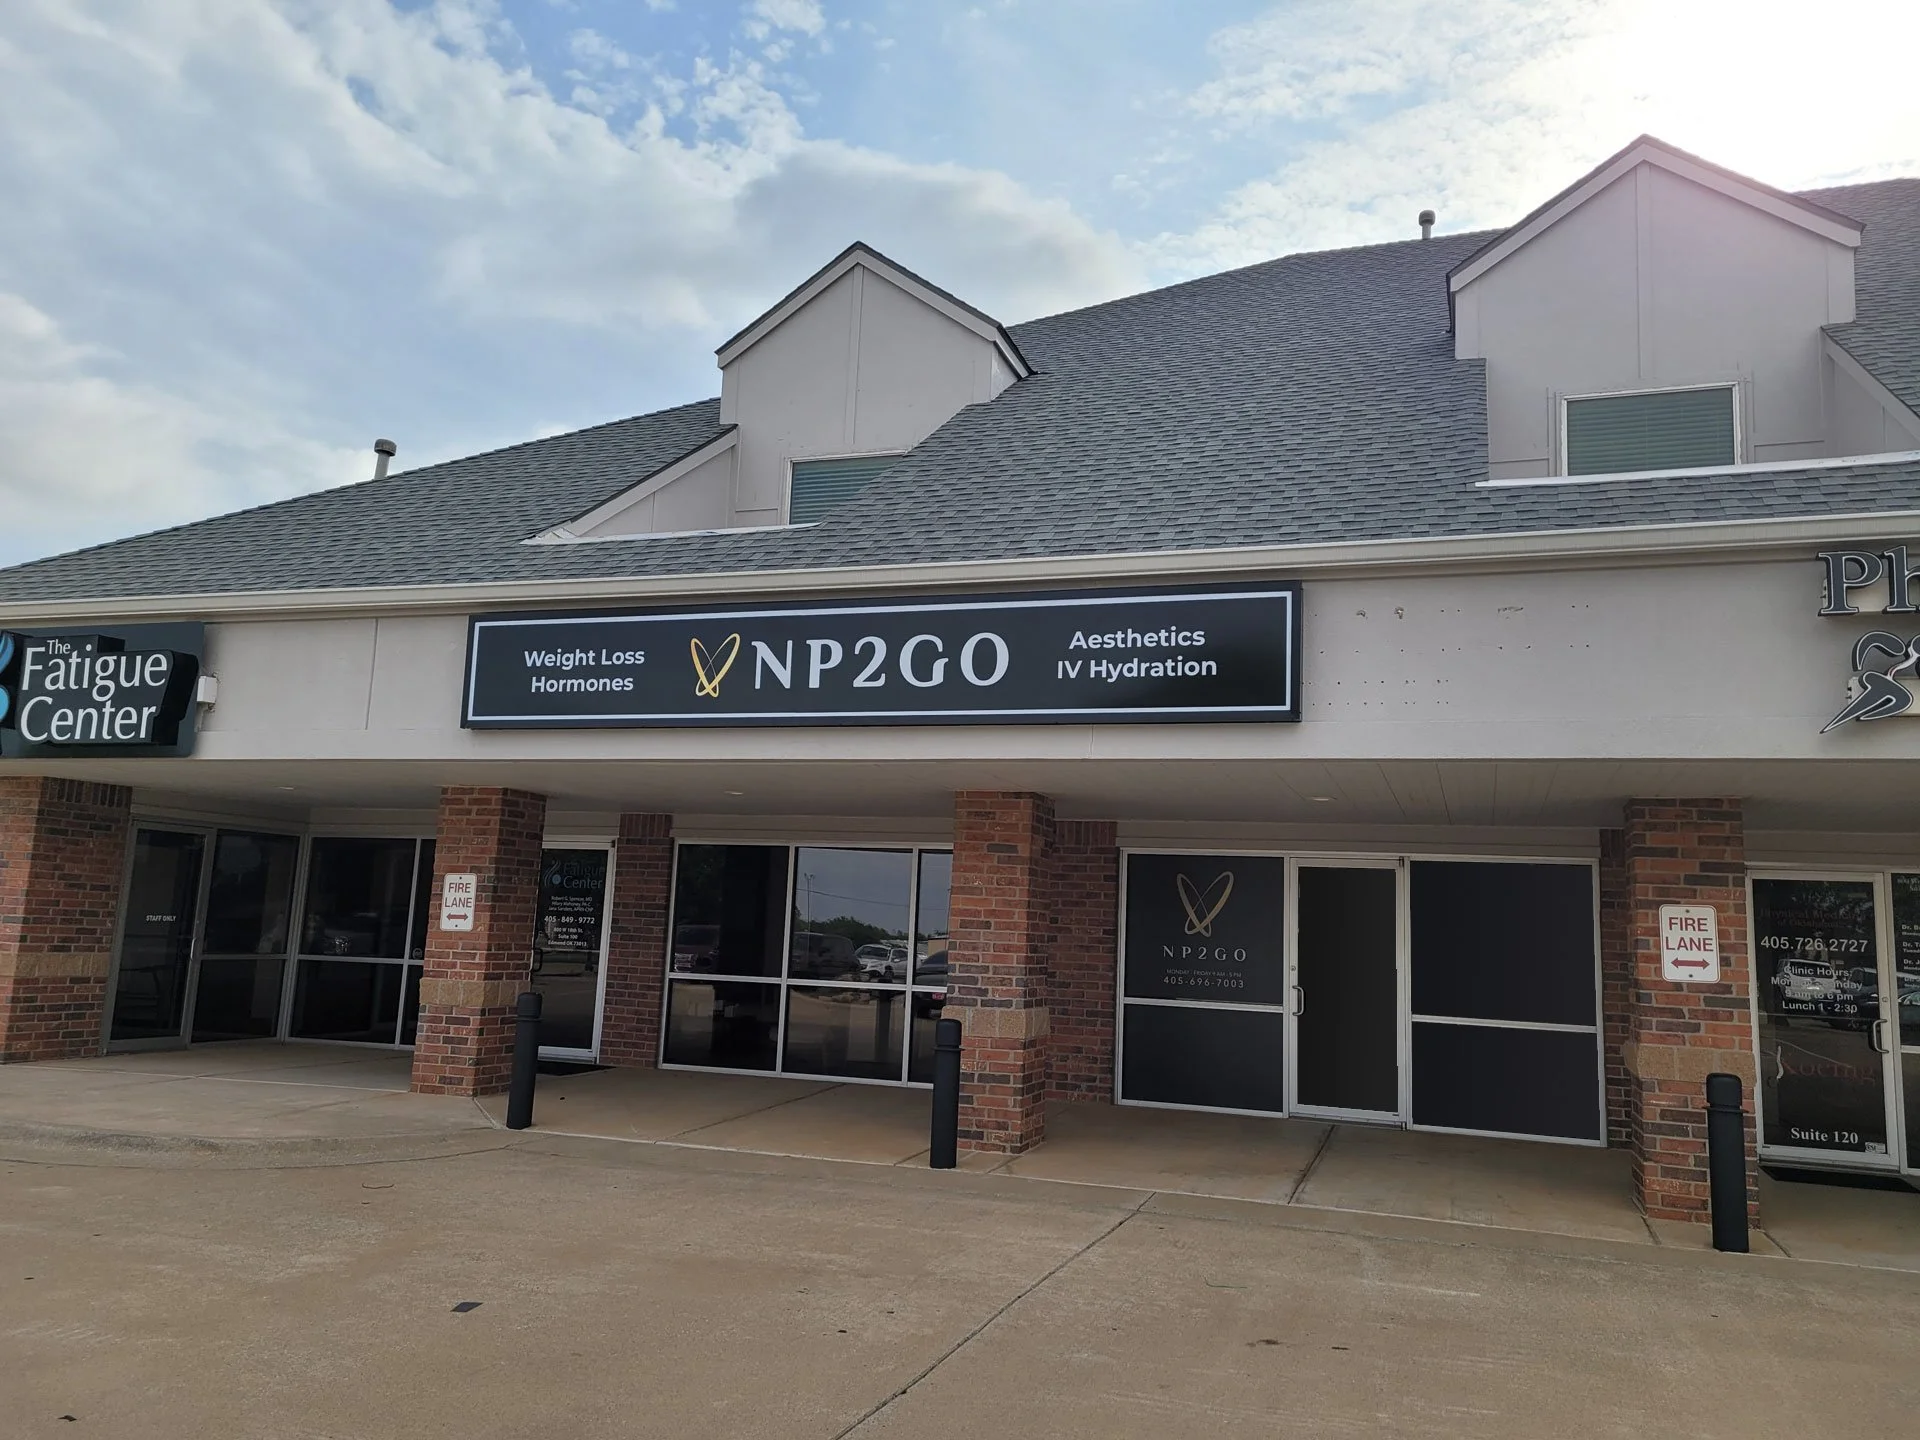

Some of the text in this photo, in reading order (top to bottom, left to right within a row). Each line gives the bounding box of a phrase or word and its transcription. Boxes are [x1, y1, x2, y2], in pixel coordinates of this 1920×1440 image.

[1069, 626, 1206, 649] Aesthetics
[47, 639, 71, 655] The
[525, 649, 645, 670] Weight Loss
[752, 632, 1011, 690] NP2GO
[22, 644, 167, 701] Fatigue
[1057, 656, 1217, 682] IV Hydration
[531, 677, 633, 692] Hormones
[20, 696, 157, 741] Center
[448, 882, 472, 893] FIRE
[563, 875, 603, 889] Center
[444, 897, 472, 908] LANE
[145, 914, 177, 922] STAFF ONLY
[578, 916, 595, 924] 9772
[1668, 916, 1709, 932] FIRE
[1665, 936, 1714, 952] LANE
[1760, 935, 1868, 953] 405.726.2727
[1162, 945, 1247, 962] NP2GO
[1783, 965, 1852, 978] Clinic Hours:
[1163, 976, 1245, 989] 405-696-7003
[1771, 976, 1813, 989] Monay
[1836, 993, 1854, 1002] pm
[1782, 1001, 1815, 1011] Lunch
[1818, 1003, 1824, 1011] 1
[1834, 1003, 1858, 1013] 2:30
[1790, 1127, 1859, 1144] Suite 120
